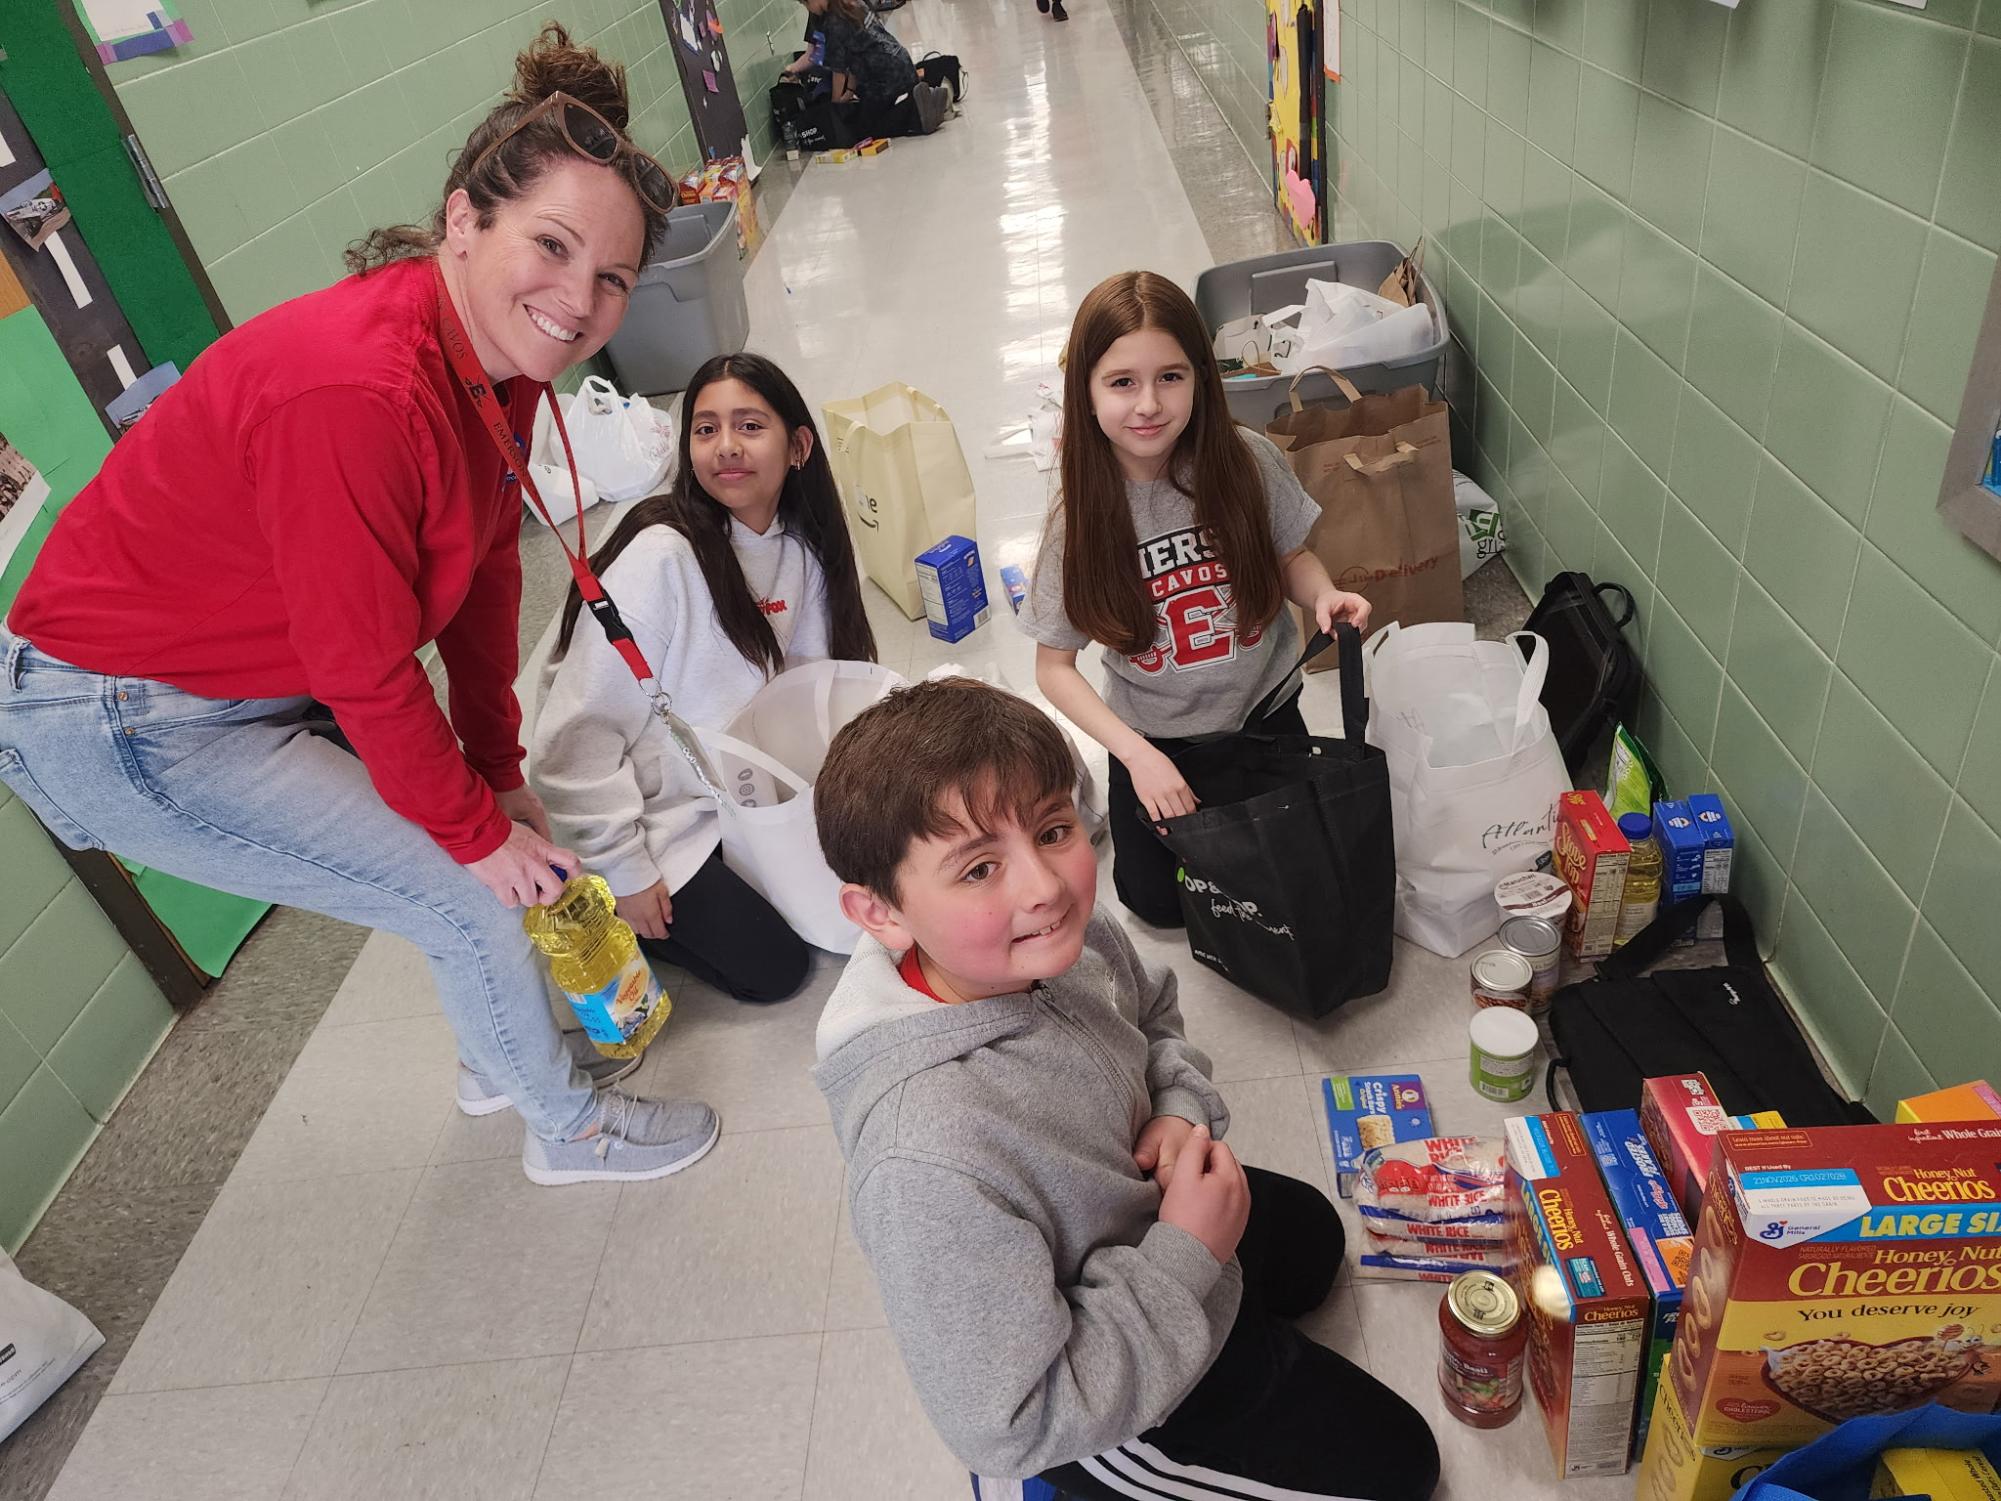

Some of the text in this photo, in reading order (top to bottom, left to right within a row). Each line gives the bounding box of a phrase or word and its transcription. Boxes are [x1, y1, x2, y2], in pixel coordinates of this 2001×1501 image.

[1151, 563, 1228, 598] CAVOS
[1160, 585, 1237, 673] E
[1482, 803, 1560, 849] Atlanti
[1556, 822, 1587, 870] Stove
[1373, 1082, 1387, 1114] Crispy
[1941, 1128, 1977, 1140] Whole
[1913, 1168, 1951, 1180] Honey
[1952, 1168, 1978, 1178] Nut
[1883, 1176, 1996, 1202] Cheerios
[1407, 1223, 1470, 1237] WHITE RICE
[1538, 1189, 1574, 1251] Cheerios
[1563, 1208, 1584, 1245] Honey Nut
[1787, 1224, 1821, 1232] General
[1859, 1212, 1963, 1238] LARGE
[1606, 1230, 1620, 1251] Whole
[1614, 1251, 1628, 1271] Grain
[1622, 1269, 1635, 1287] Oats
[1874, 1246, 2001, 1265] Honey Nut
[1788, 1261, 2001, 1297] Cheerios
[1584, 1308, 1639, 1322] Cheerios
[1798, 1302, 1980, 1321] You deserve joy
